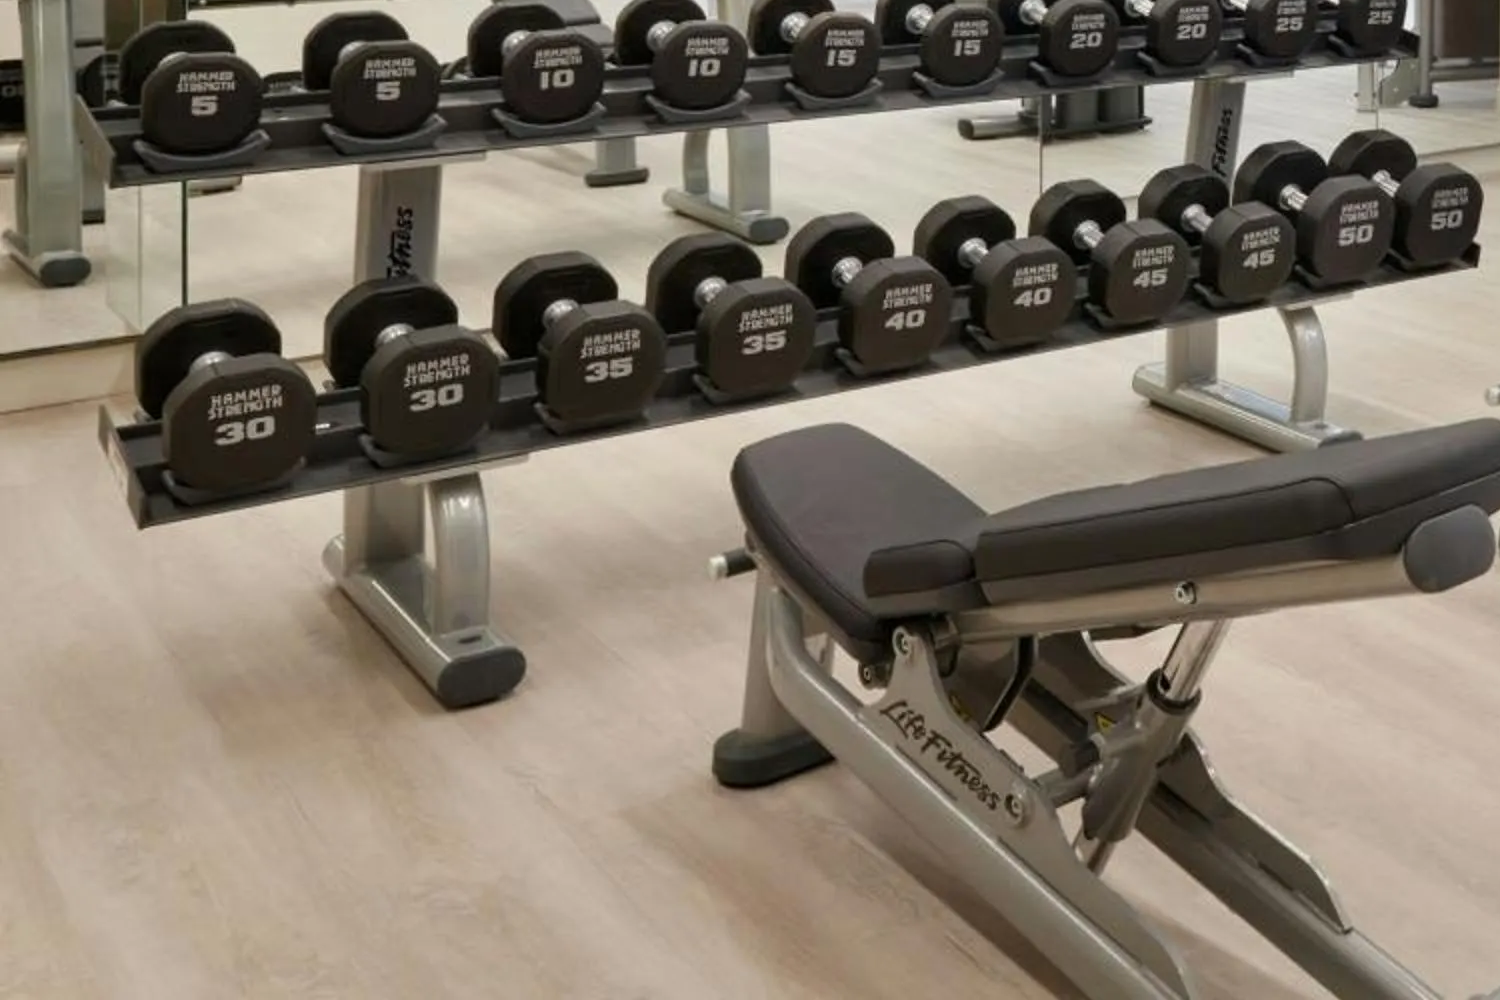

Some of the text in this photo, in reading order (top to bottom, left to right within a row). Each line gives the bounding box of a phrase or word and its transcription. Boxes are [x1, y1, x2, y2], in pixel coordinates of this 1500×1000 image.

[1276, 16, 1303, 32] 25
[1368, 10, 1393, 24] 25
[1070, 32, 1102, 49] 20
[1177, 23, 1205, 39] 20
[954, 39, 981, 56] 15
[688, 59, 720, 77] 10
[826, 49, 857, 67] 15
[540, 68, 575, 90] 10
[376, 81, 400, 101] 5
[191, 95, 218, 116] 5
[1431, 210, 1463, 231] 50
[1338, 224, 1374, 247] 50
[1242, 249, 1275, 269] 45
[1133, 268, 1168, 288] 45
[1014, 287, 1052, 307] 40
[884, 309, 926, 331] 40
[742, 330, 787, 356] 35
[584, 356, 633, 383] 35
[211, 384, 282, 406] HAMMER
[409, 383, 464, 411] 30
[214, 415, 275, 446] 30
[921, 729, 1001, 811] Fitness
